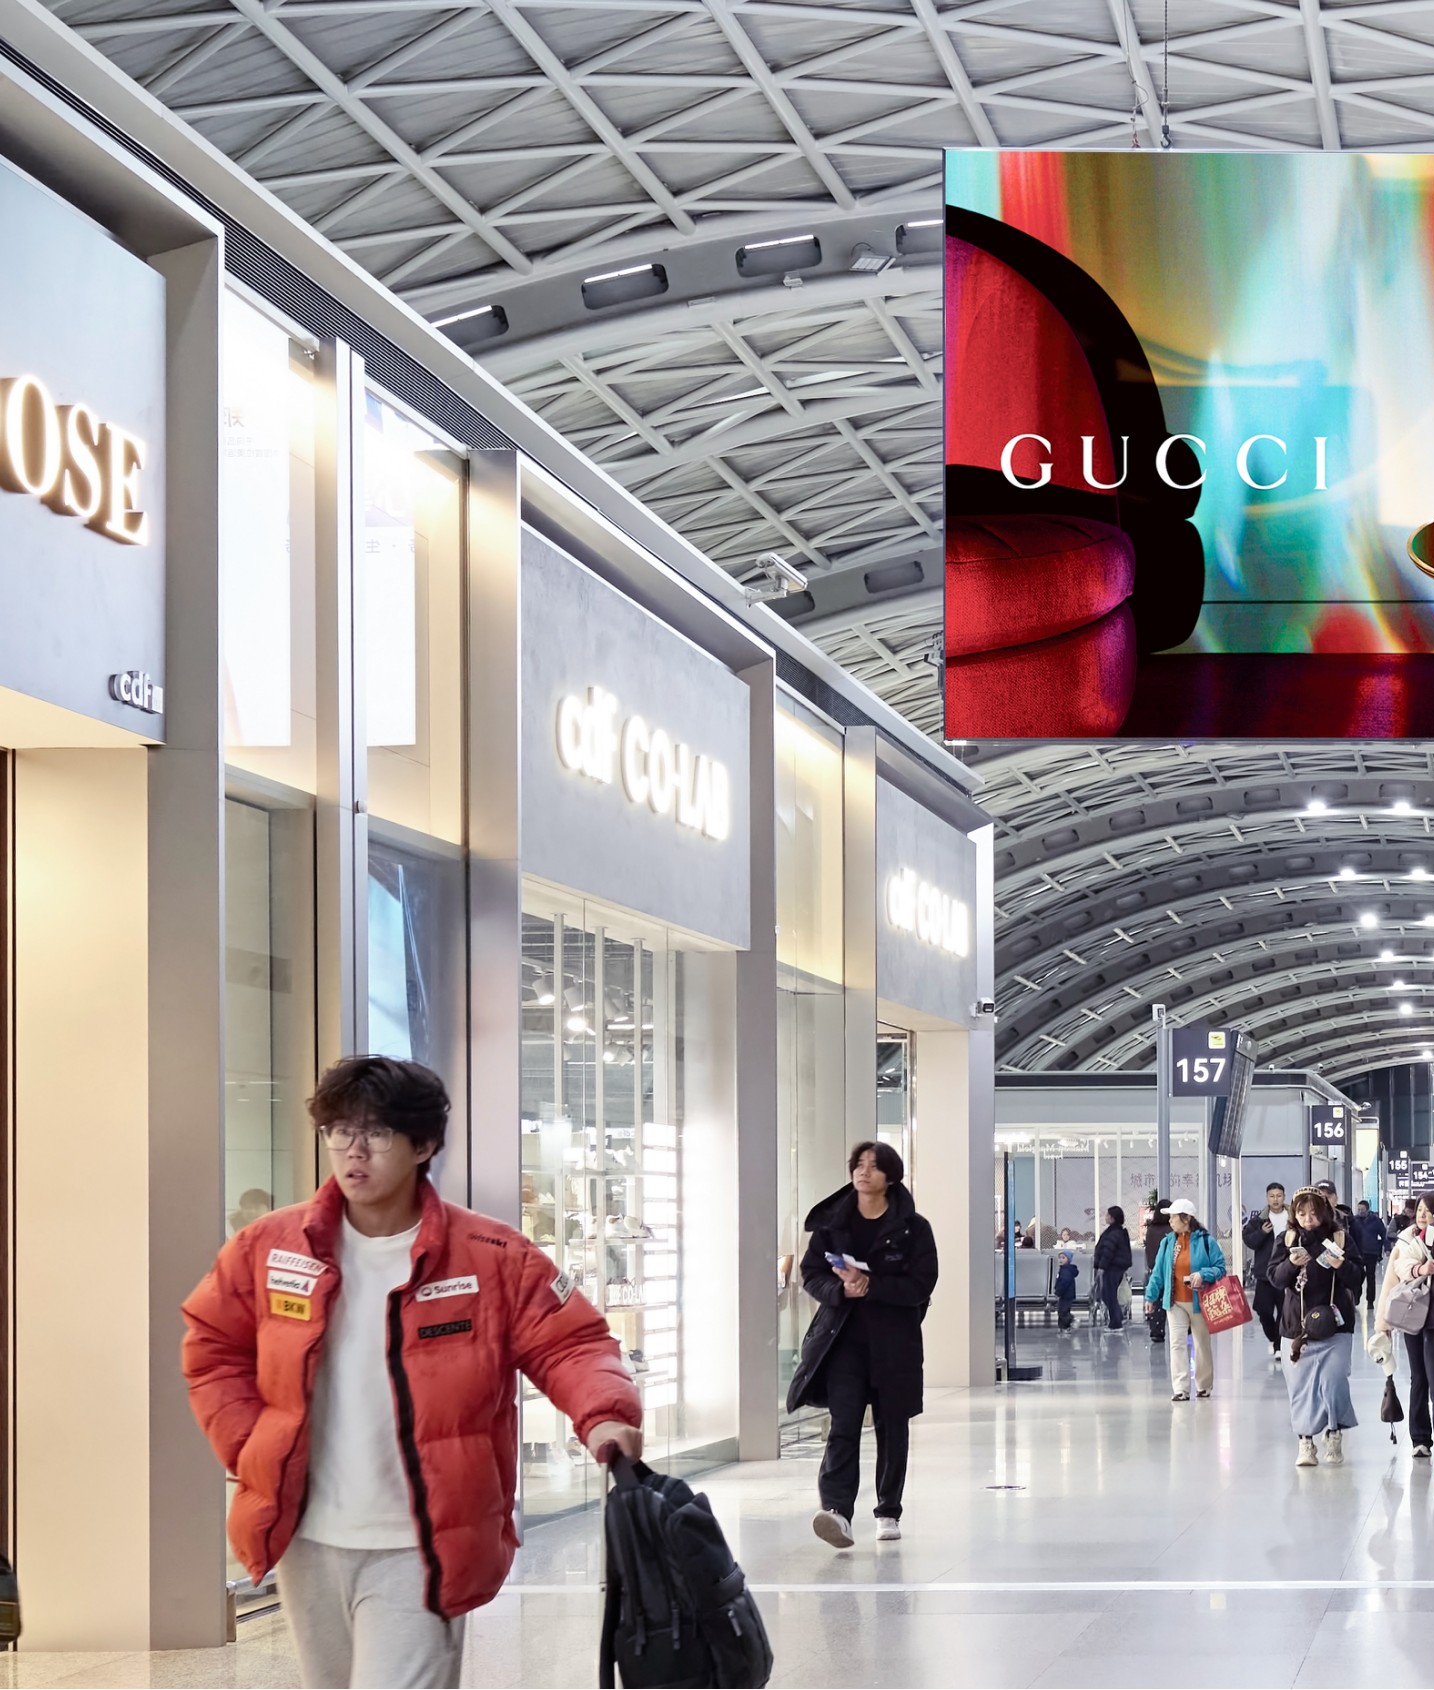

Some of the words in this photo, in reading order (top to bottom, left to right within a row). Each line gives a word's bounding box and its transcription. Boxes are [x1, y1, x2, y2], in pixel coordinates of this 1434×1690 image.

[1000, 433, 1328, 490] GUCCI
[556, 685, 618, 785] cdf
[1177, 1058, 1226, 1083] 157
[1314, 1122, 1344, 1138] 156
[1389, 1160, 1407, 1170] 155
[1413, 1170, 1428, 1180] 154
[272, 1253, 324, 1272] RAIFFEISEN
[434, 1281, 473, 1294] Sunrise
[284, 1300, 305, 1315] BKW
[420, 1321, 471, 1338] DESCENTE
